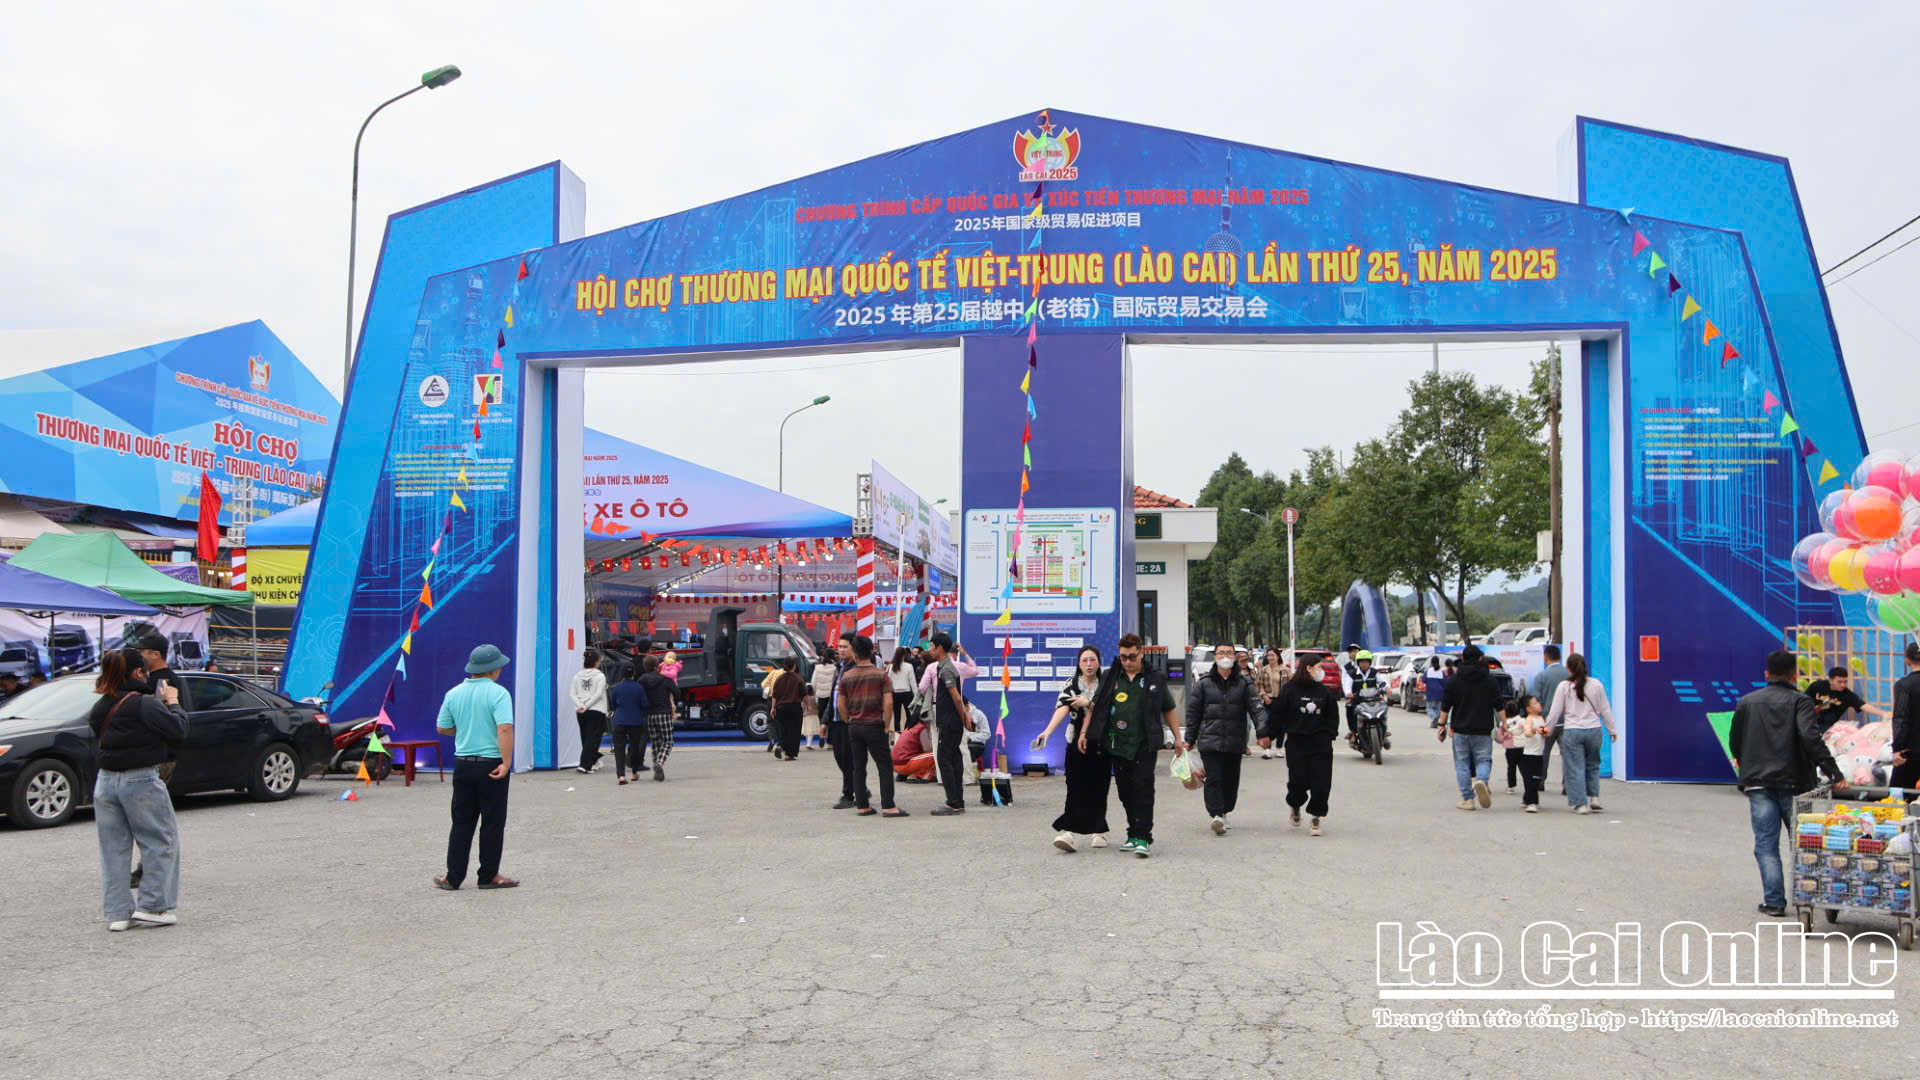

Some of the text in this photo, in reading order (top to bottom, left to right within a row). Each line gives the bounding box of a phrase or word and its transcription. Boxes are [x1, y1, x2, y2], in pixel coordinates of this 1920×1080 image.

[1049, 168, 1077, 180] 2025
[796, 203, 857, 223] CHƯƠNG
[861, 197, 907, 218] TRÌNH
[911, 193, 942, 214] CẤP
[947, 189, 988, 214] QUỐC
[993, 194, 1019, 210] GIA
[1048, 186, 1079, 207] XÚC
[1084, 186, 1120, 206] TIẾN
[1125, 189, 1187, 205] THƯƠNG
[1191, 189, 1225, 208] MẠI
[1228, 186, 1266, 205] NĂM
[1269, 189, 1310, 205] 2025
[576, 241, 1559, 316] HỘI CHỢ THƯƠNG MẠI QUỐC TẾ VIỆT-TRUNG (LÀO CAI) LẦN THỨ 25, NĂM 2025
[835, 306, 886, 327] 2025
[36, 412, 100, 446] THƯƠNG
[103, 427, 132, 456] MẠI
[135, 433, 171, 461] QUỐC
[173, 441, 189, 465] TẾ
[191, 446, 217, 472] VIỆT
[224, 455, 261, 481] TRUNG
[263, 462, 286, 487] (LÀO
[287, 468, 308, 491] CAI)
[213, 421, 298, 465] HỘI CHỢ
[592, 472, 606, 485] LẦN
[607, 473, 621, 485] THỨ
[621, 475, 633, 486] 25,
[633, 473, 650, 485] NĂM
[652, 475, 668, 485] 2025
[594, 498, 688, 518] XE Ô TÔ
[1150, 564, 1161, 573] 2A
[265, 575, 275, 584] XE
[254, 591, 267, 602] HỤ
[269, 588, 287, 602] KIỆN
